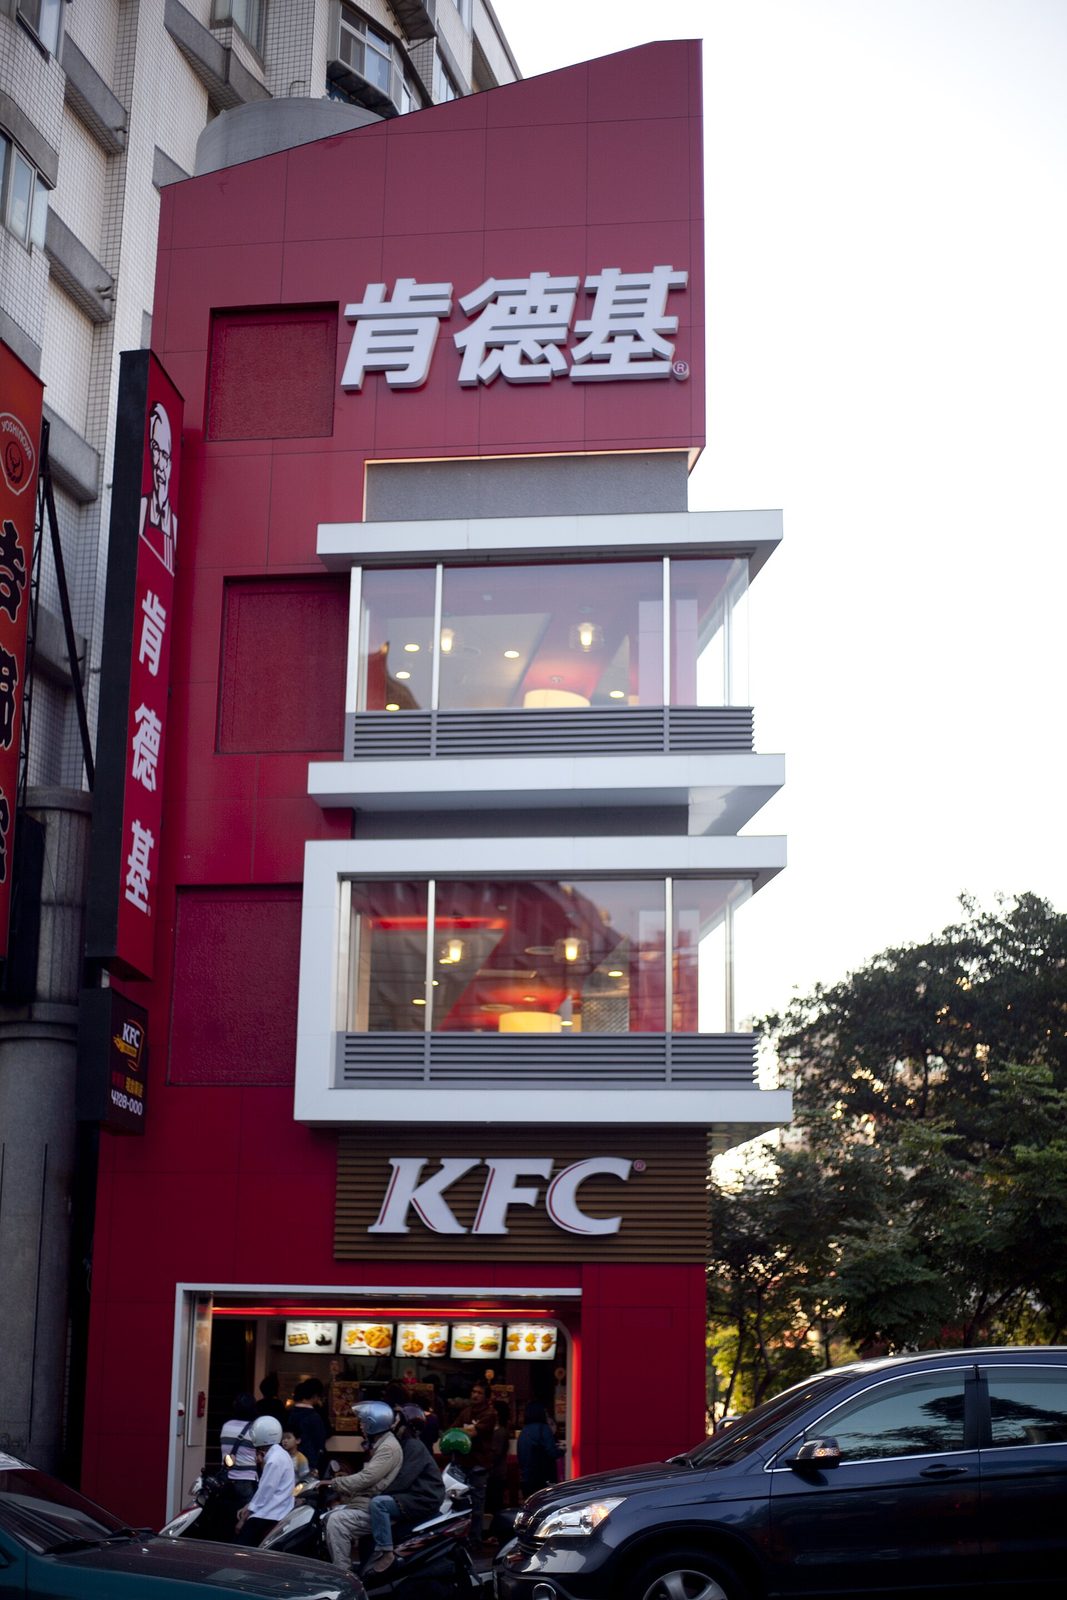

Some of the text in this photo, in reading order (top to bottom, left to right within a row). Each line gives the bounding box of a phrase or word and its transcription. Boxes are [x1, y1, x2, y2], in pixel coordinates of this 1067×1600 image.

[341, 265, 689, 391] 肯德基
[124, 589, 167, 914] 肯德基
[122, 1022, 141, 1048] KFC
[367, 1156, 633, 1236] KFC
